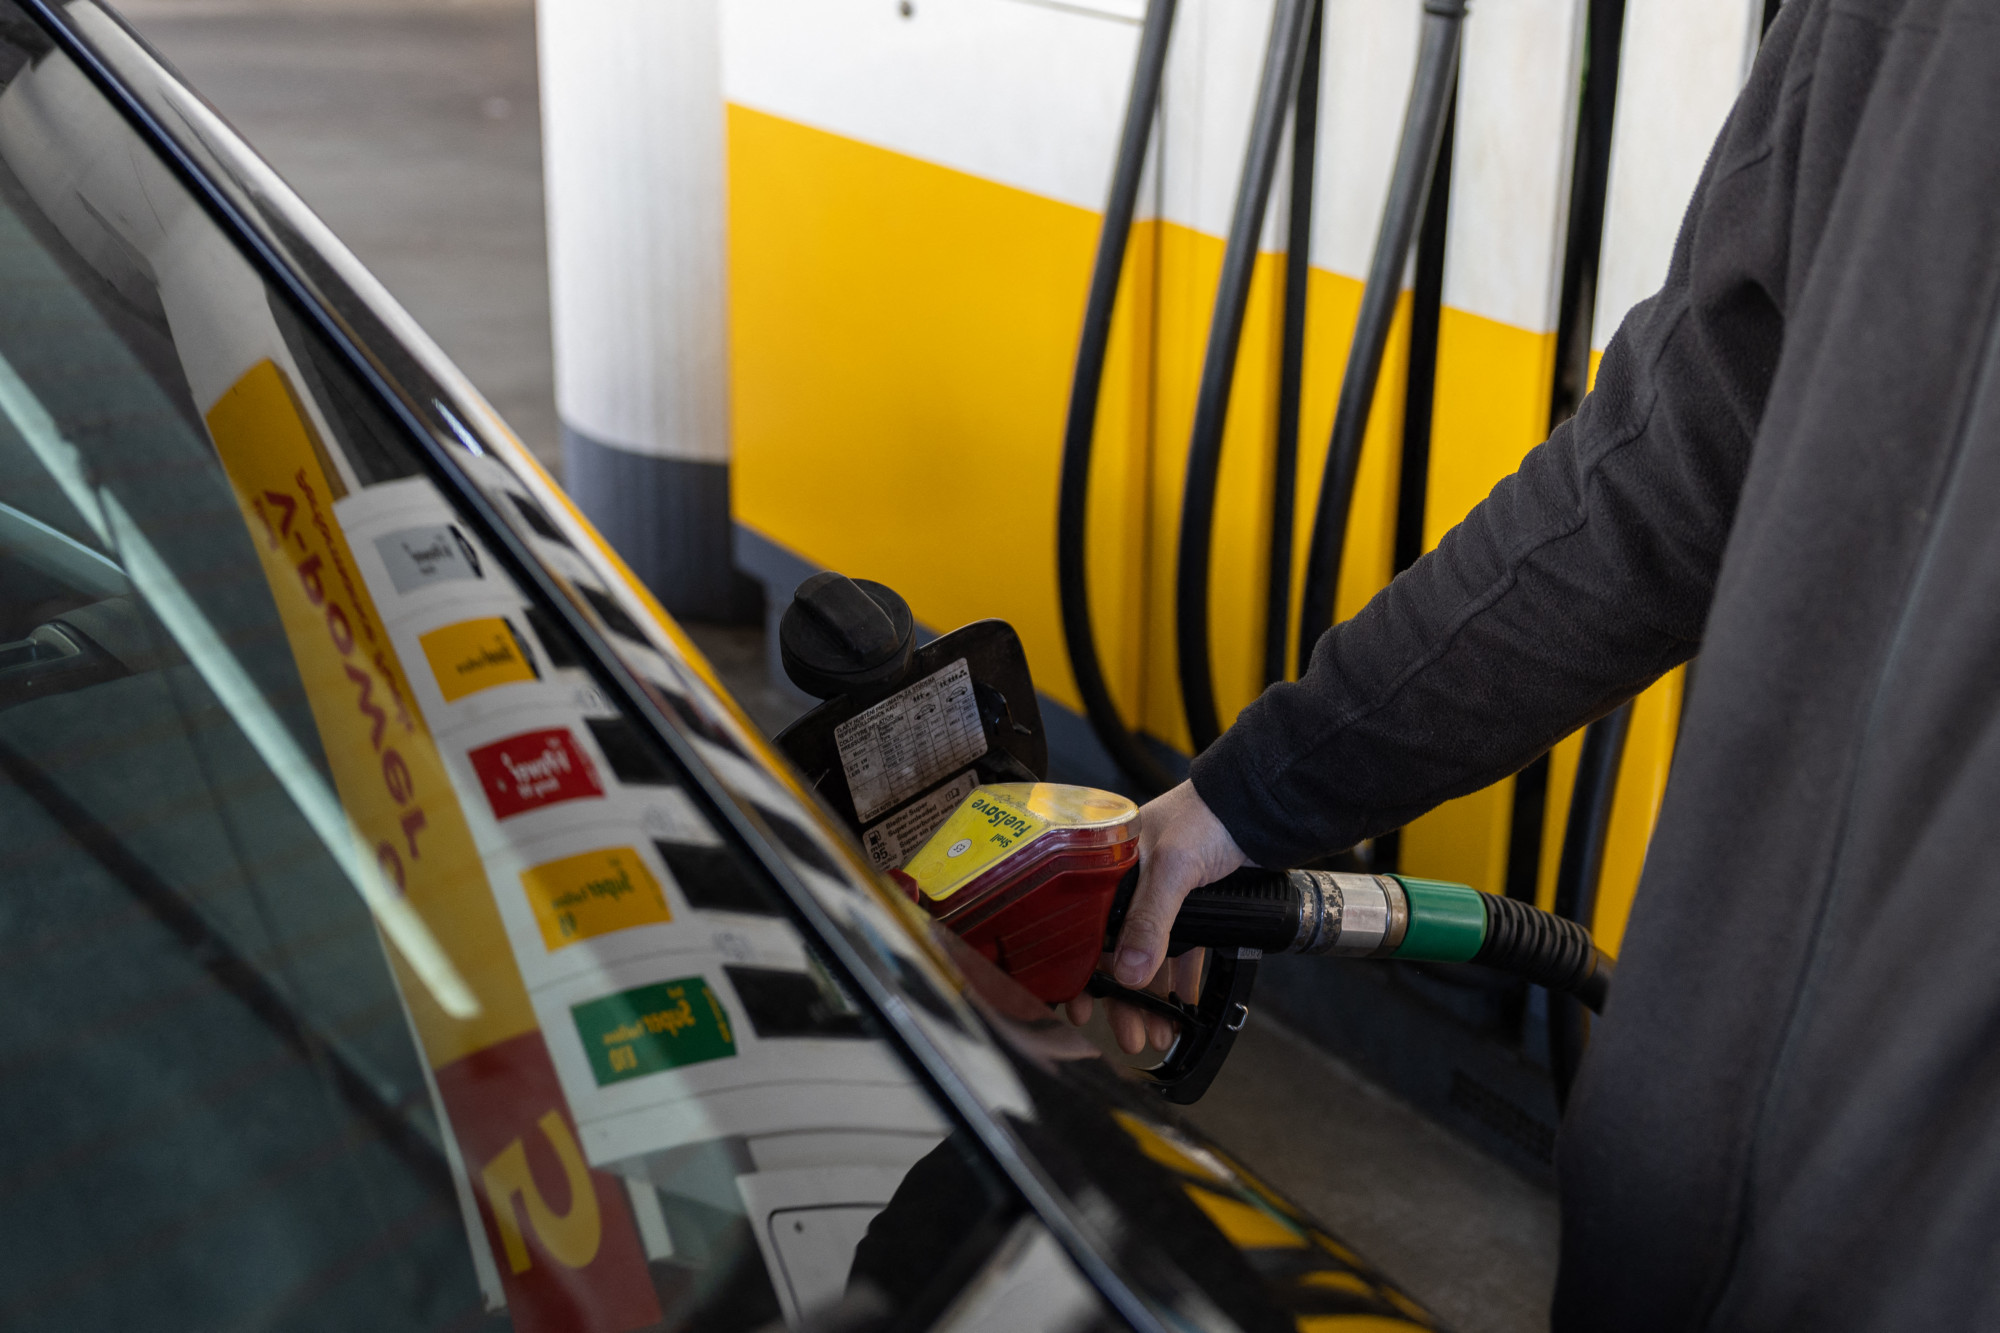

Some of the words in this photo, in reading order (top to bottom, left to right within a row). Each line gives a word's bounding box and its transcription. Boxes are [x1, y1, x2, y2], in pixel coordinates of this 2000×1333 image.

[908, 800, 928, 816] Super
[887, 821, 907, 838] Super
[907, 803, 937, 825] unleaded
[971, 799, 1032, 838] FuelSave
[898, 832, 919, 848] Super
[989, 833, 1012, 848] Shell
[871, 846, 888, 864] 95
